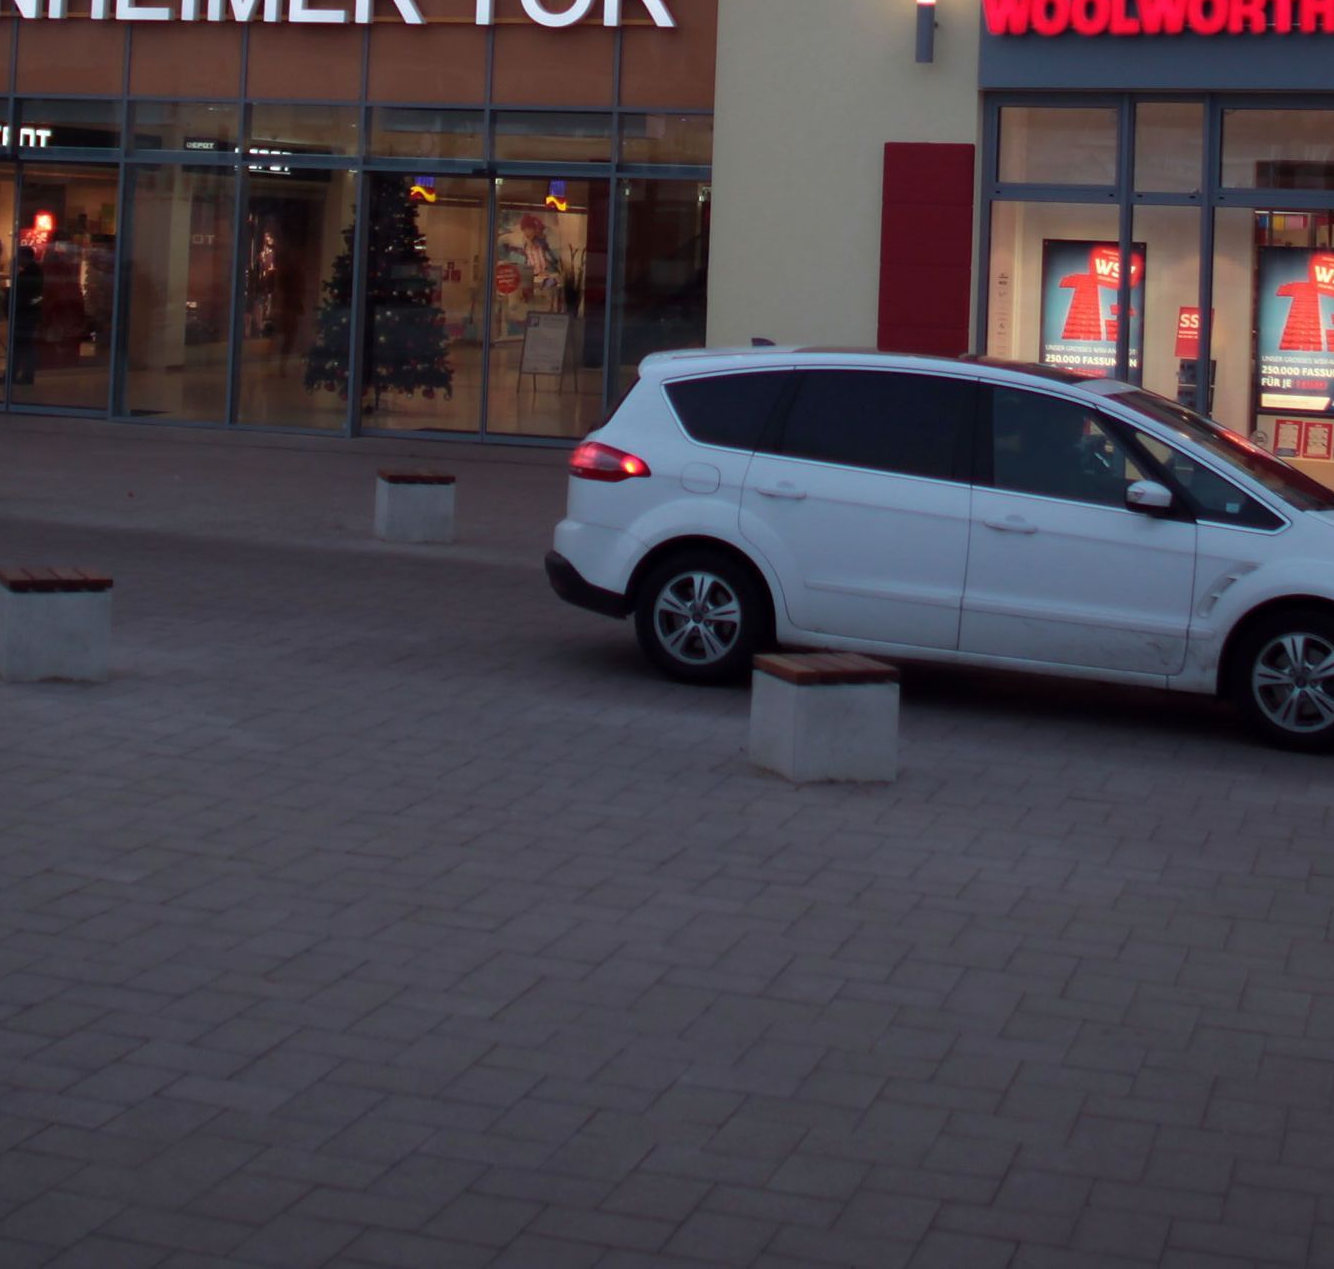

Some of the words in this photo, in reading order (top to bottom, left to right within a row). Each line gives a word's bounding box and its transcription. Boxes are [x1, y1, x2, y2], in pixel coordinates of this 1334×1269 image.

[1095, 258, 1136, 278] WS
[1045, 354, 1081, 364] 250.000
[1082, 356, 1138, 368] FASSUNN
[1261, 365, 1300, 375] 250.000
[1261, 376, 1281, 387] FÜR
[1282, 379, 1292, 388] JE
